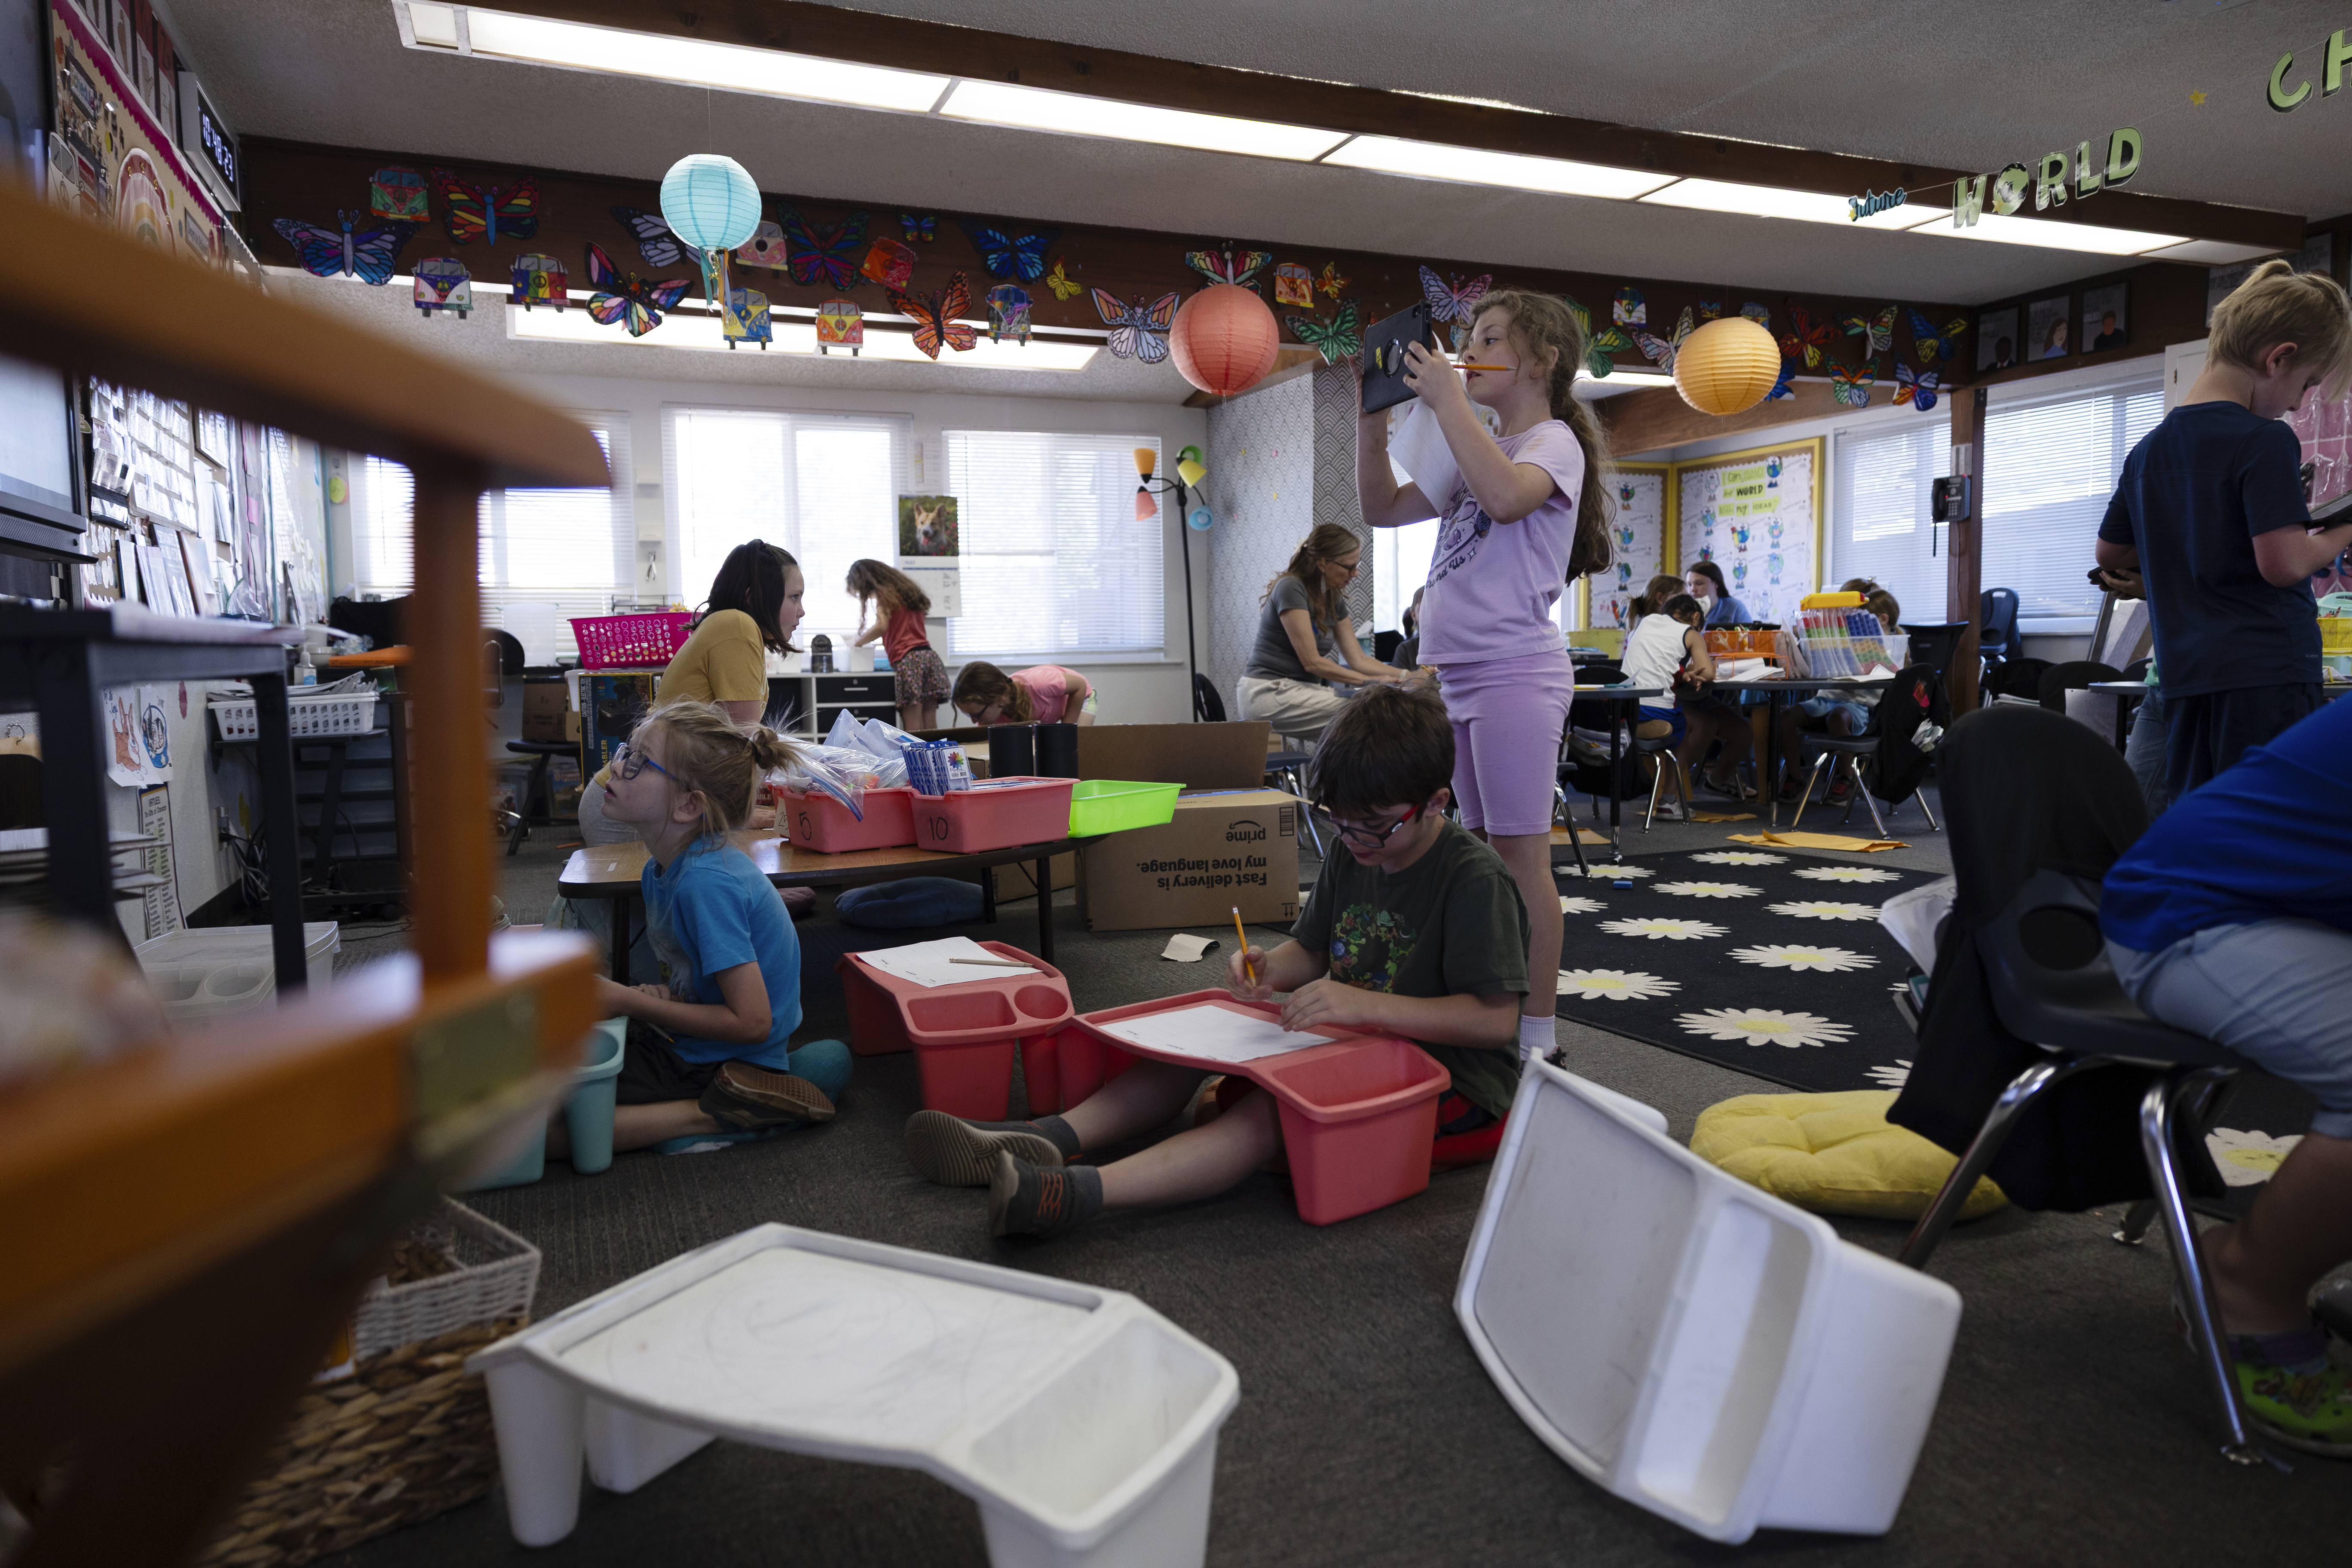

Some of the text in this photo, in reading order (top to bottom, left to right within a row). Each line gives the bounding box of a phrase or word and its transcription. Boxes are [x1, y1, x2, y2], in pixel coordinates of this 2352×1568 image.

[202, 113, 234, 182] 10:48:23
[1953, 127, 2143, 229] WORLD
[1736, 485, 1763, 496] WORLD
[1449, 555, 1466, 570] Us
[778, 812, 789, 830] 25
[799, 811, 812, 841] 5
[930, 816, 948, 841] 10
[1226, 827, 1266, 844] prime
[1136, 855, 1267, 873] my love language.
[1157, 873, 1267, 891] Fast delivery is
